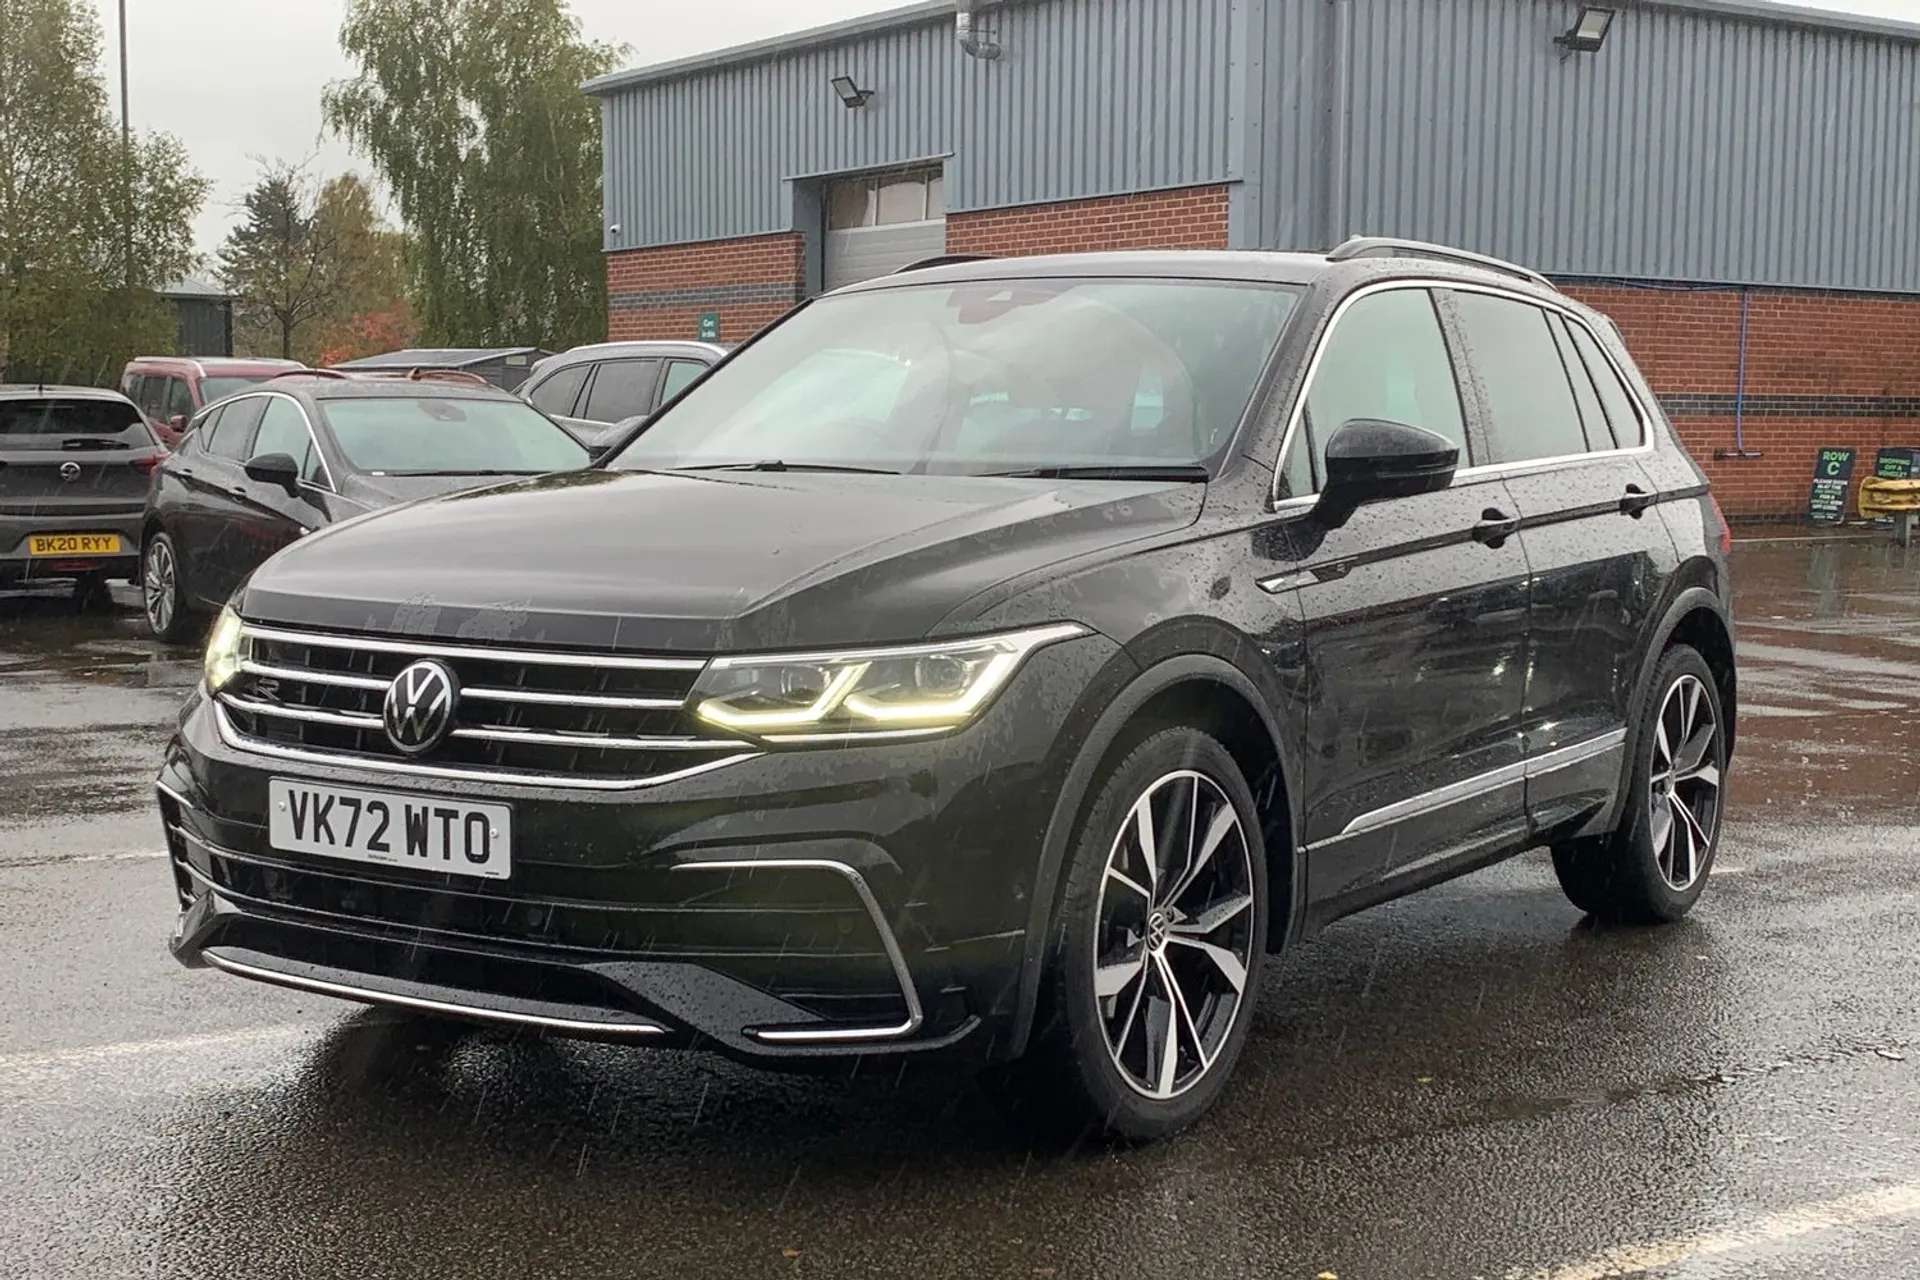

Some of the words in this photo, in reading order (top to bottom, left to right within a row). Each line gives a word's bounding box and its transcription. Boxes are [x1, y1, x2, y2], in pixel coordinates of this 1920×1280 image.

[1822, 451, 1850, 461] ROW
[1827, 461, 1840, 475] C
[35, 537, 77, 552] BK20
[81, 537, 112, 551] RYY
[288, 789, 391, 853] VK72
[405, 804, 491, 864] WTO
